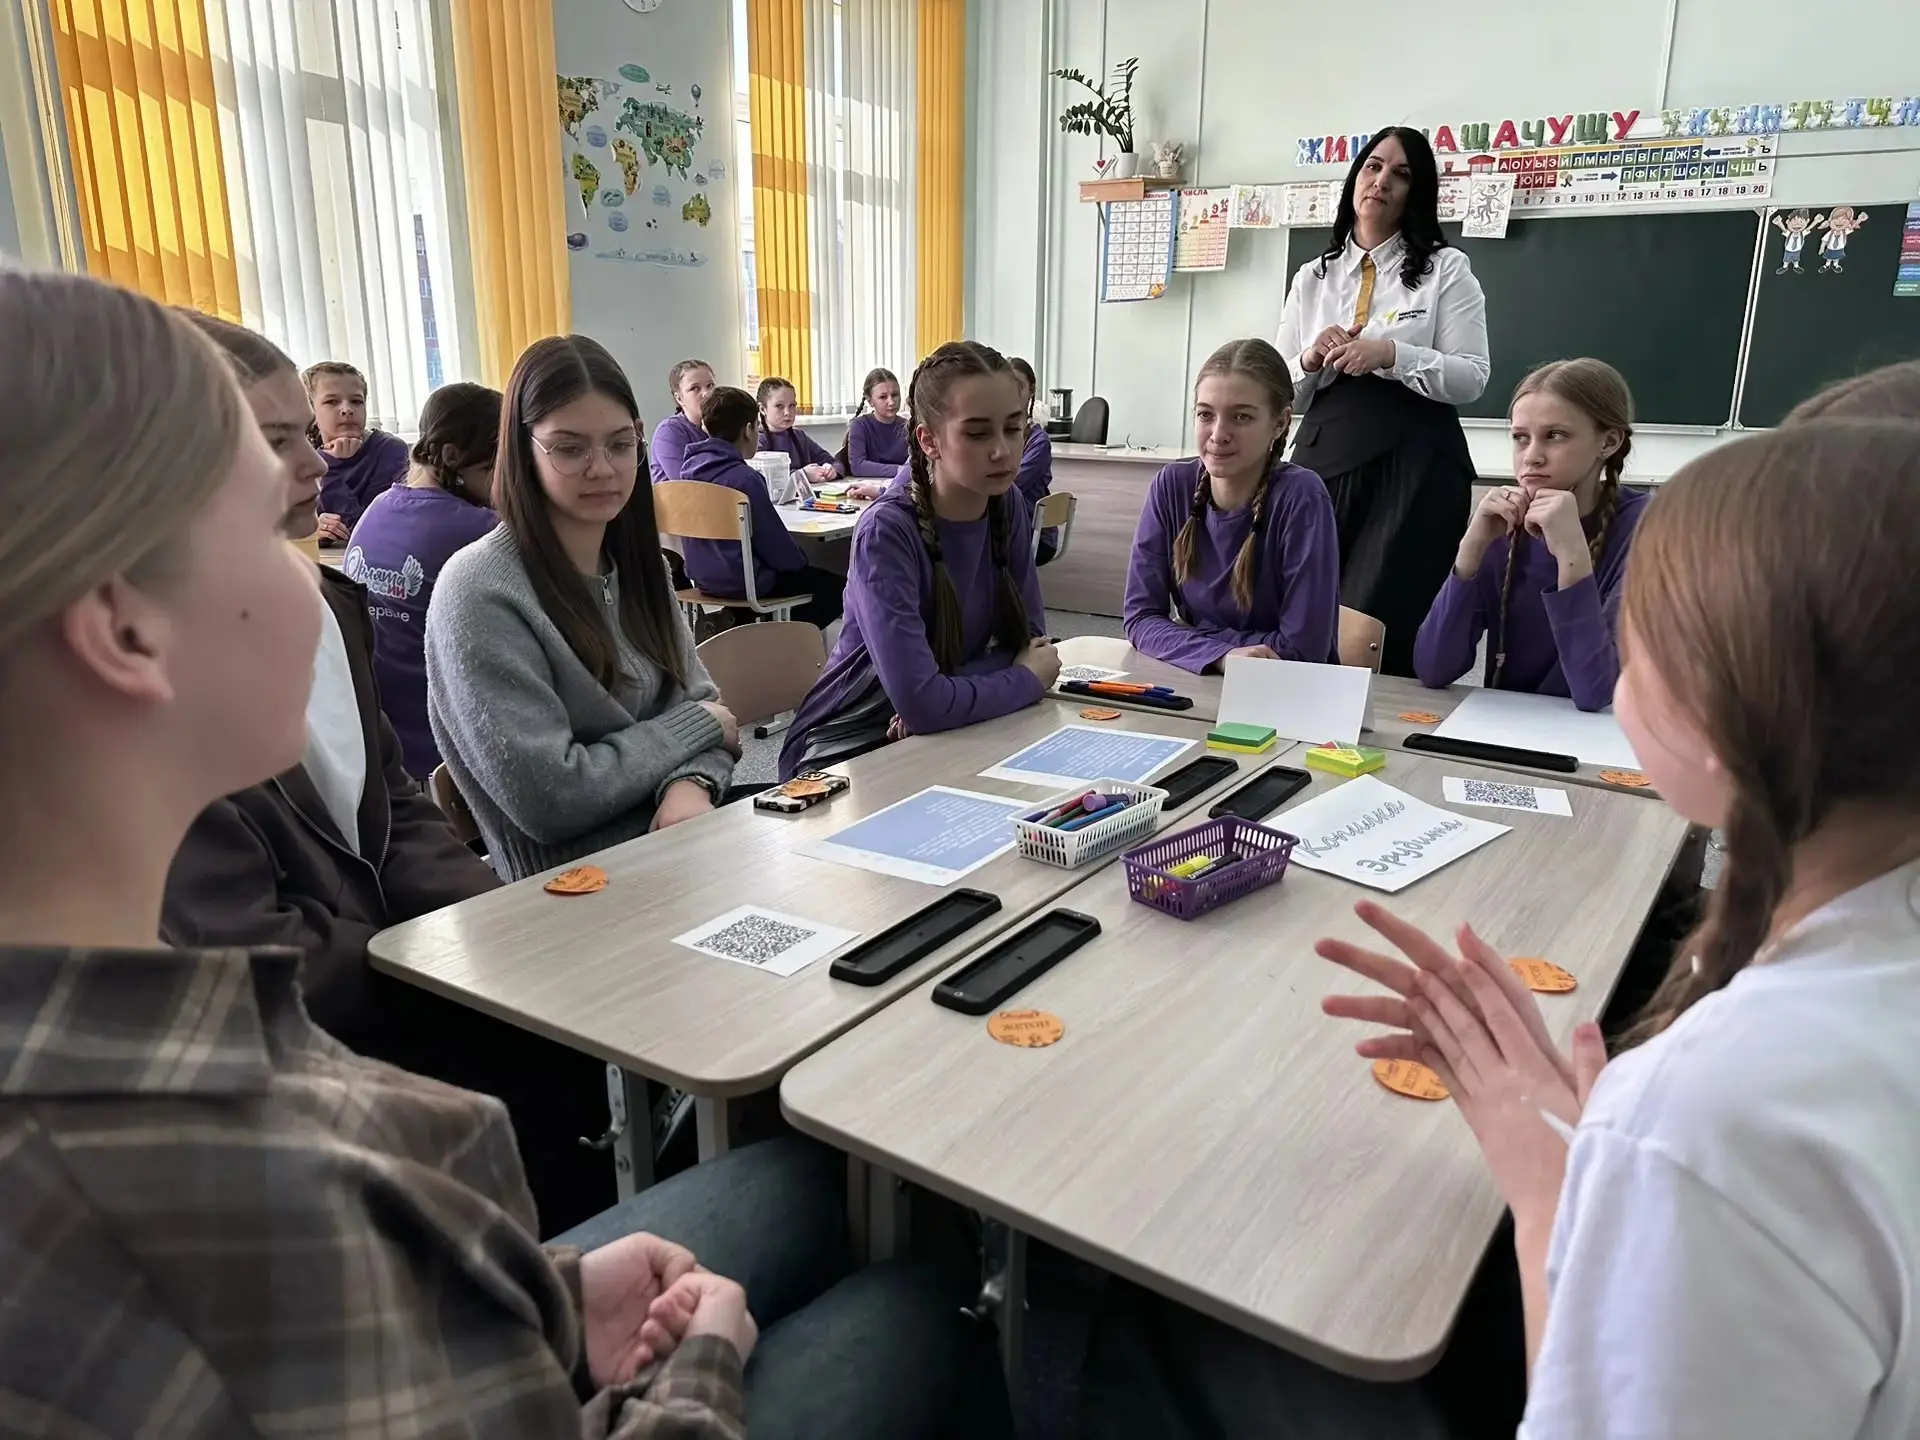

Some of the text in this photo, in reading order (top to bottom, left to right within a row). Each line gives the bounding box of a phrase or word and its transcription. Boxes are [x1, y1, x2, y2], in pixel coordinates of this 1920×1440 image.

[1183, 189, 1208, 197] ЧИСЛА
[1524, 196, 1530, 204] 6
[1539, 195, 1545, 204] 7
[1555, 195, 1560, 203] 8
[1585, 194, 1595, 202] 10
[1601, 193, 1610, 201] 11
[1617, 192, 1627, 200] 12
[1633, 191, 1643, 199] 13
[1650, 190, 1659, 199] 14
[1667, 190, 1677, 198] 15
[1683, 189, 1694, 197] 16
[1701, 188, 1711, 196] 17
[1718, 187, 1729, 195] 18
[1735, 186, 1746, 194] 19
[1753, 185, 1764, 193] 20
[367, 606, 410, 622] ервые
